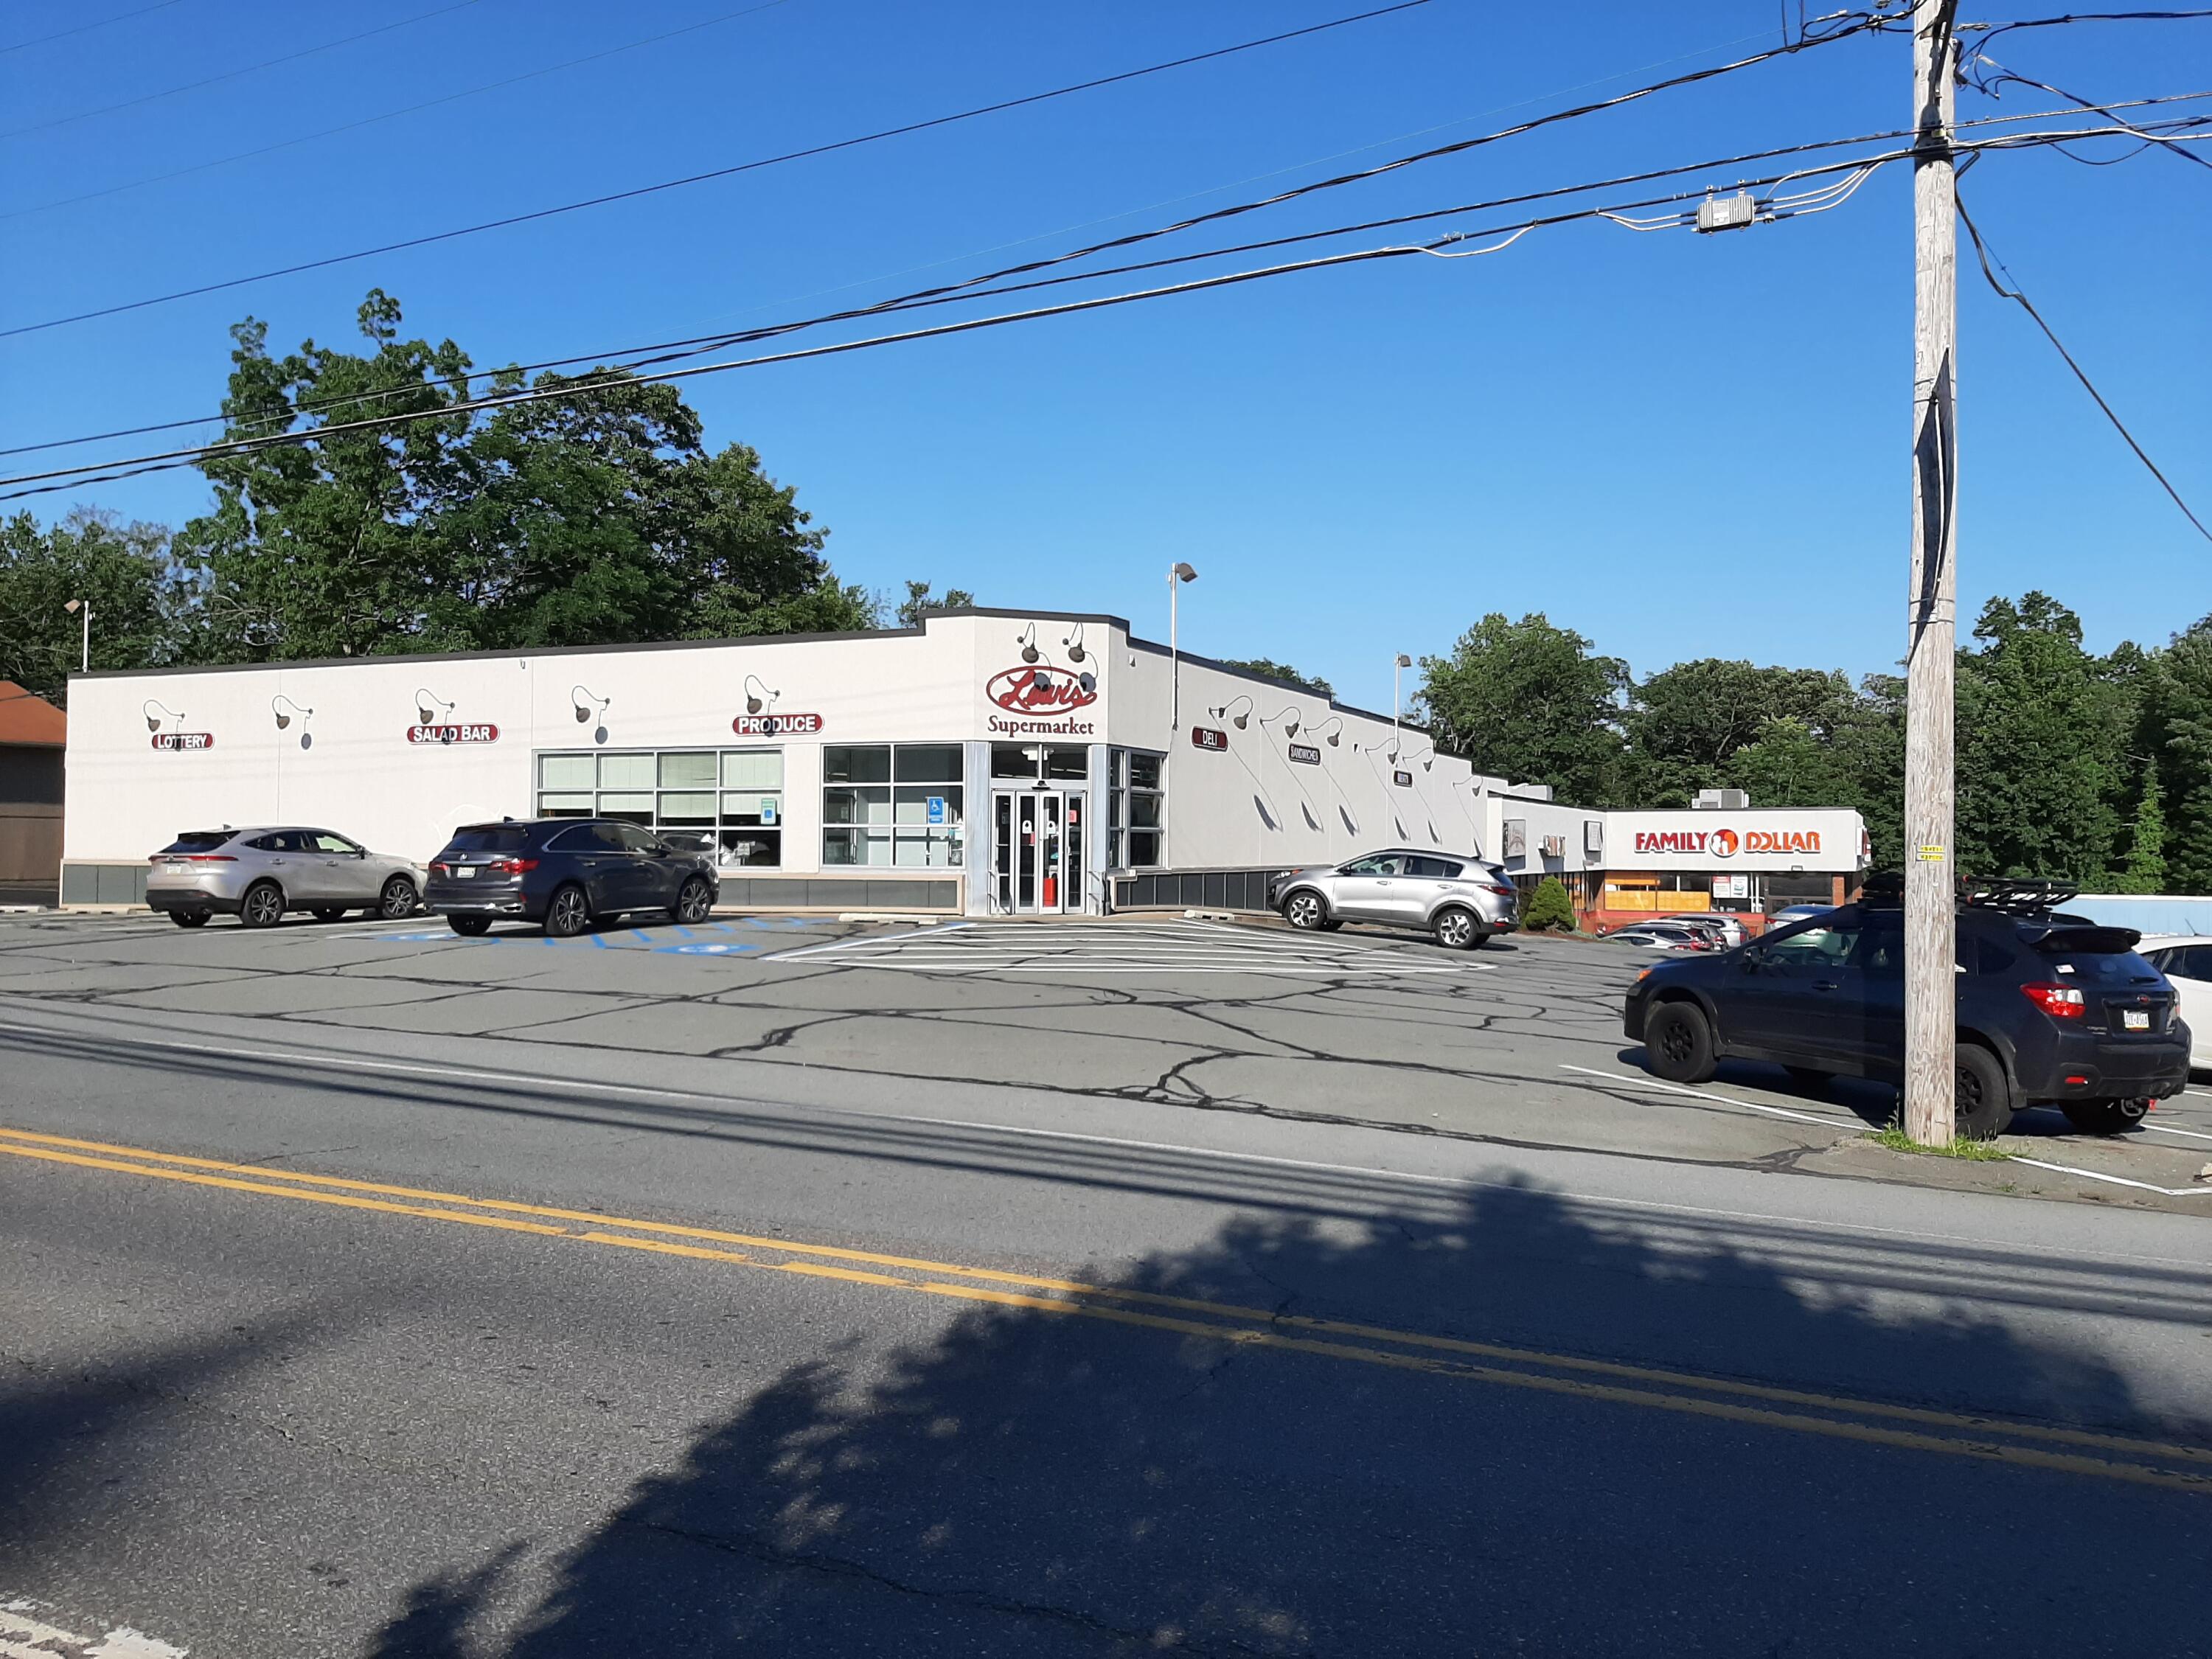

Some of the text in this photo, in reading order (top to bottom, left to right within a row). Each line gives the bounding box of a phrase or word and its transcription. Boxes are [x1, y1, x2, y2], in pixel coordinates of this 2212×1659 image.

[413, 725, 490, 742] SALAD BAR
[738, 715, 815, 734] PRODUCE
[987, 715, 1095, 738] Supermarket
[157, 734, 207, 748] LOTTERY
[1203, 730, 1217, 746] DELI
[1635, 831, 1821, 851] FAMILY DOLLAR
